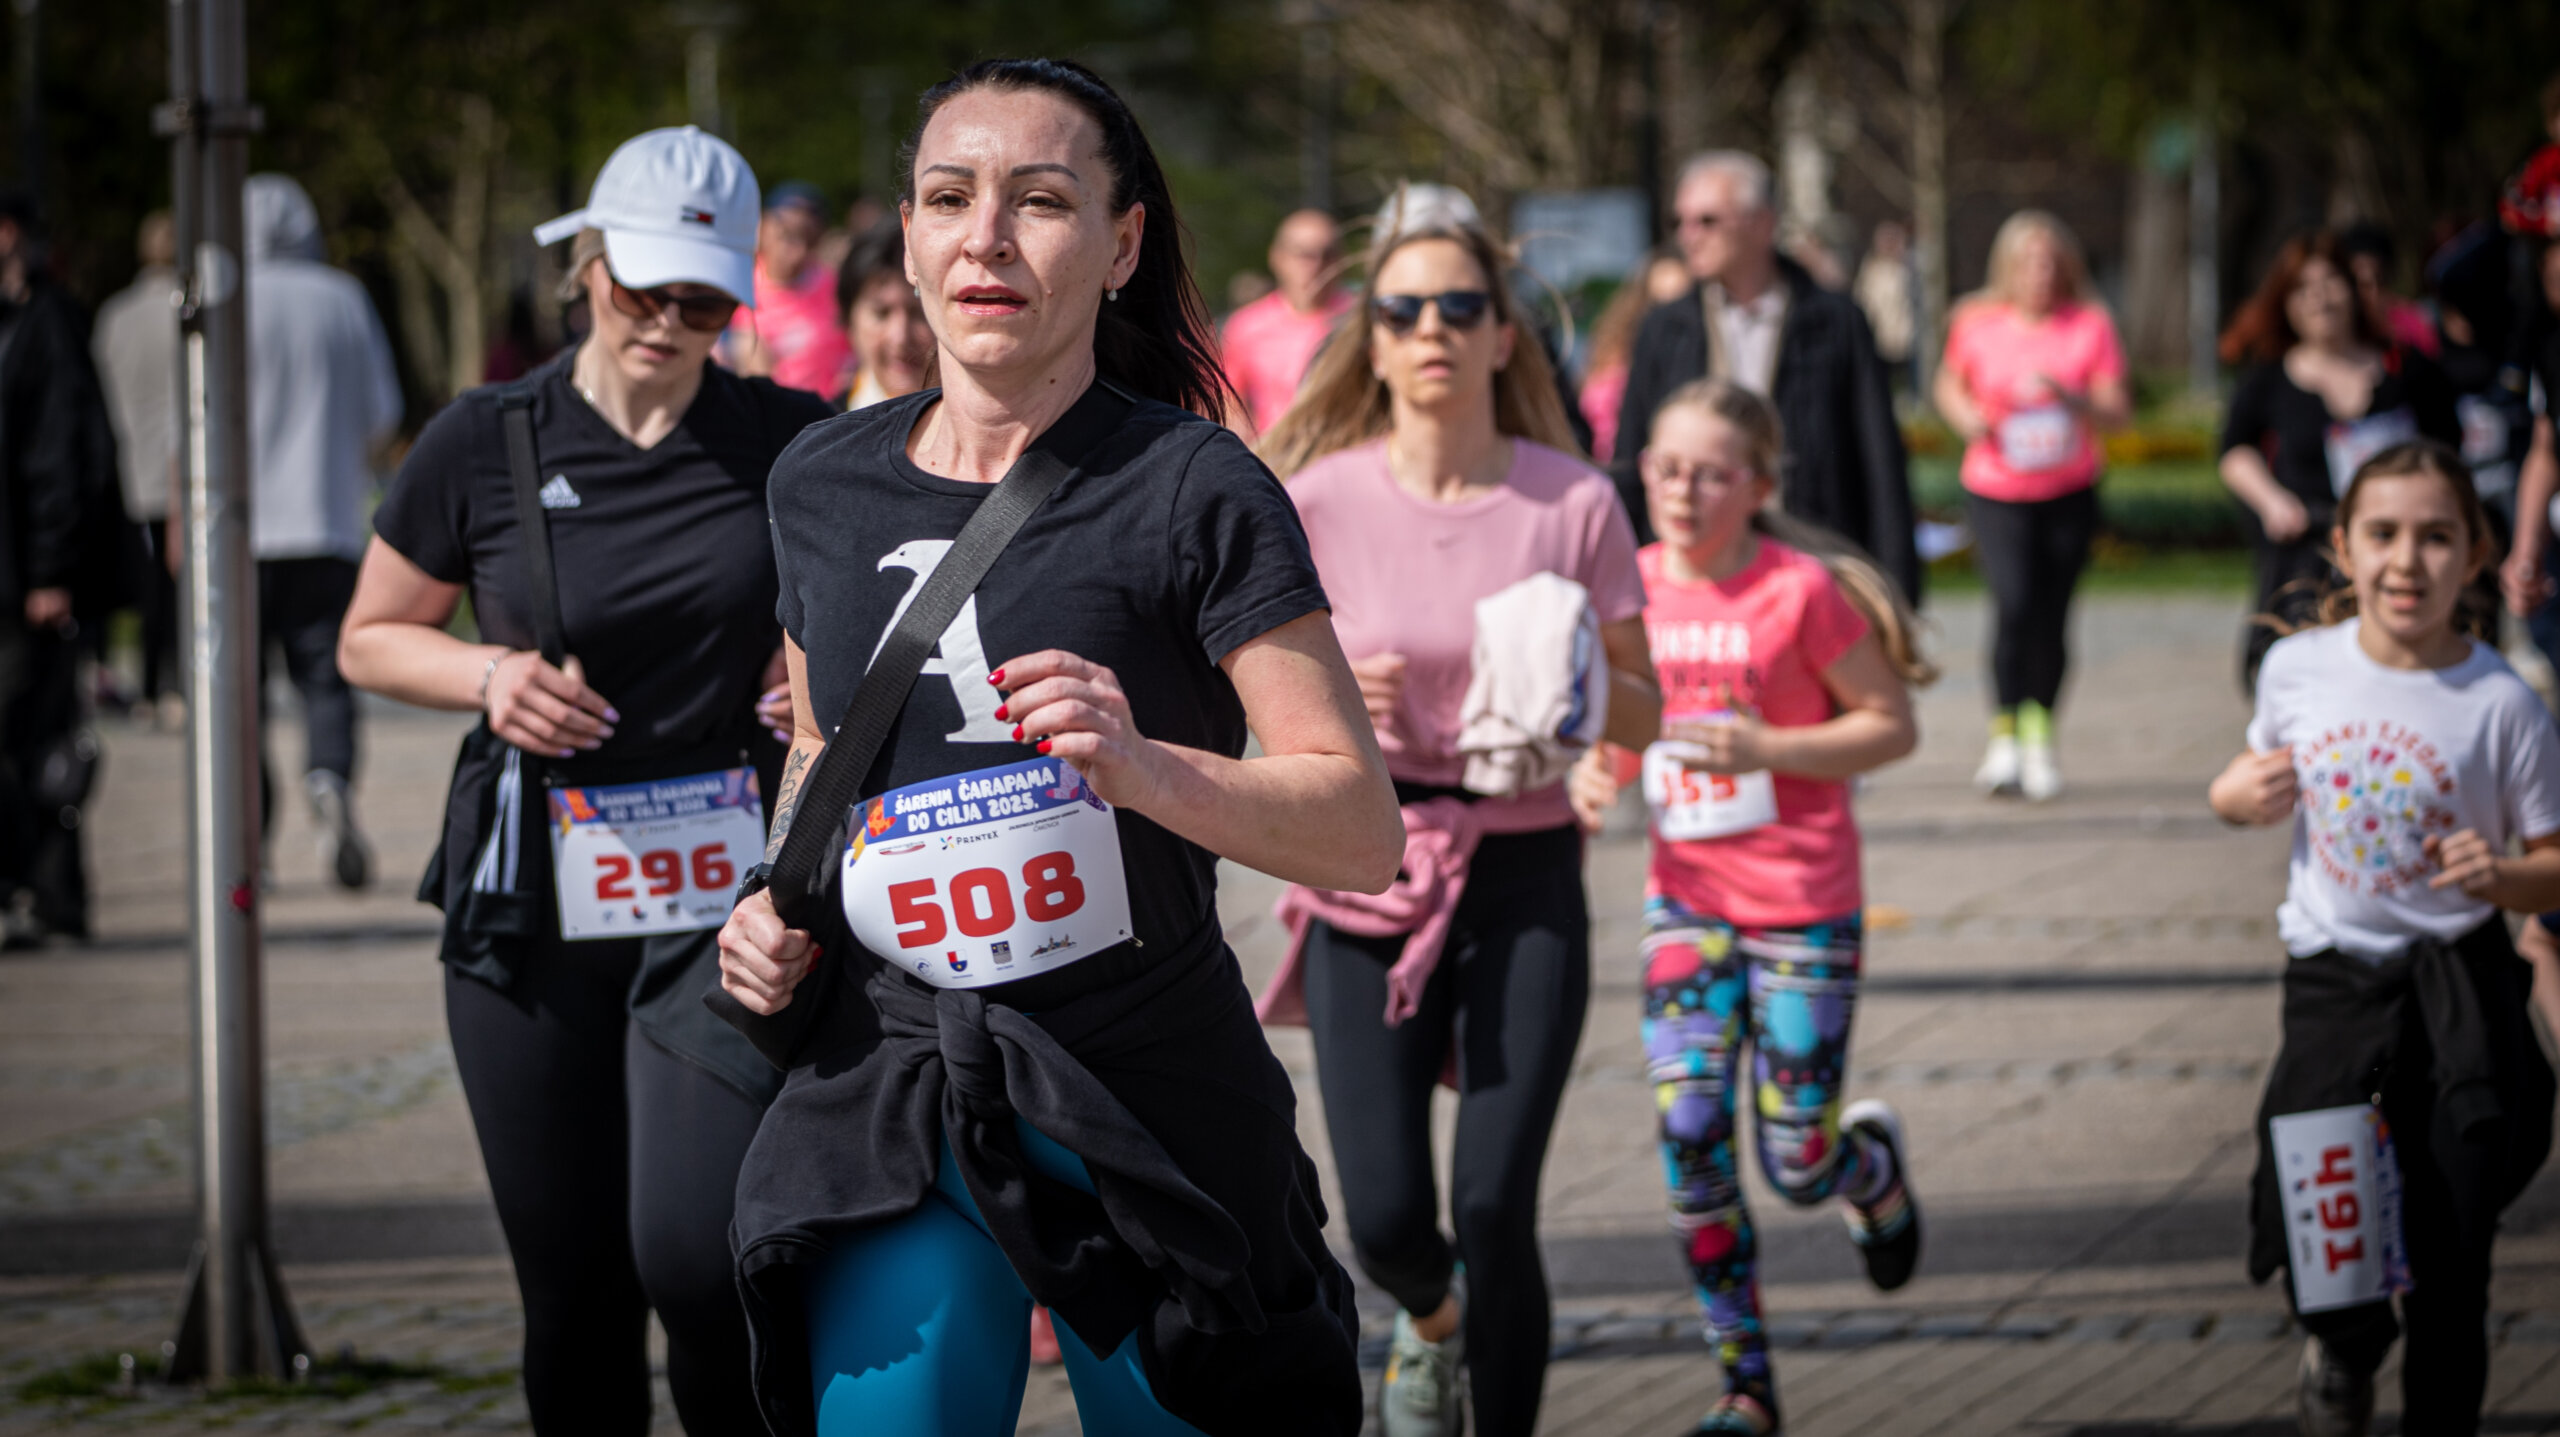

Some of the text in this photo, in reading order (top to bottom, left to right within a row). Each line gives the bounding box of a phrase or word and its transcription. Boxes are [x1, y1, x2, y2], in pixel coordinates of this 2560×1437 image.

[895, 766, 1056, 815] ŠARENIM ČARAPAMA
[907, 812, 930, 833] DO
[936, 802, 982, 829] CILJA
[987, 792, 1039, 817] 2025.
[595, 841, 734, 901] 296
[888, 851, 1086, 949] 508
[2314, 1143, 2365, 1274] 491
